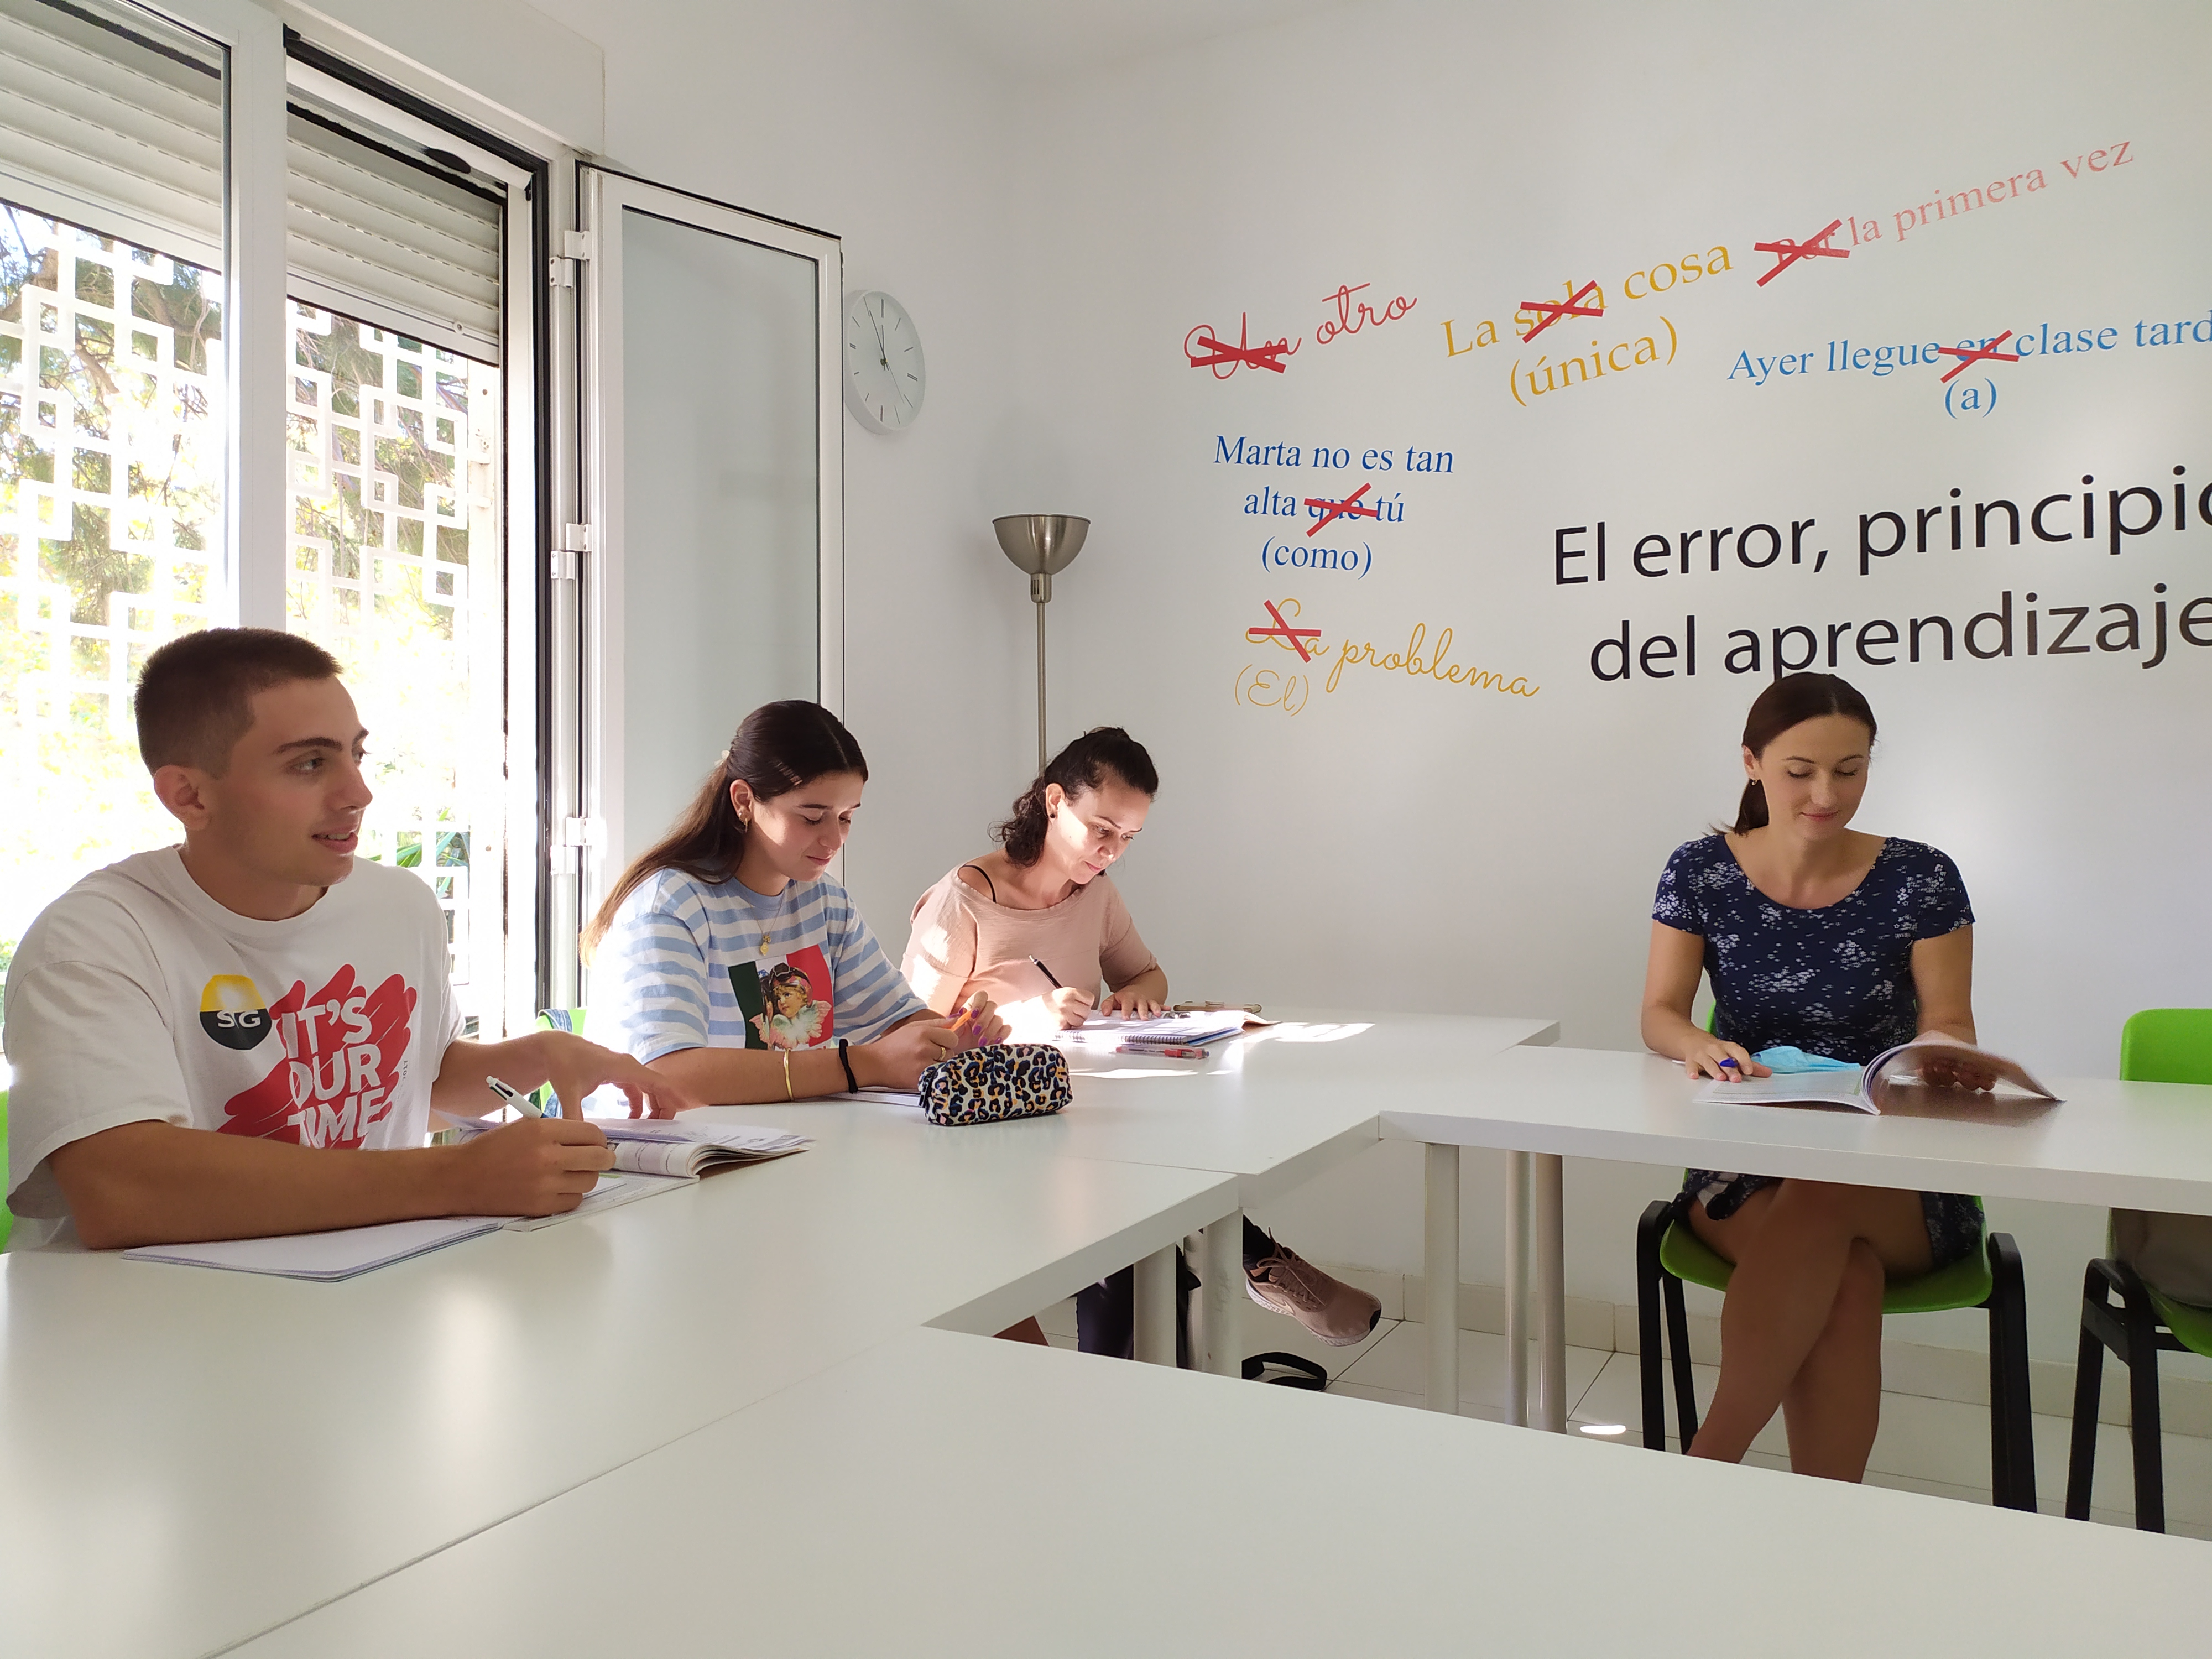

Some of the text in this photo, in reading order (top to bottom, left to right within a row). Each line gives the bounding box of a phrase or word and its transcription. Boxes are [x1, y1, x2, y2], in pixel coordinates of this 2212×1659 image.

[1848, 216, 1882, 246] la
[1893, 169, 2047, 241] primera
[2060, 141, 2134, 179] vez
[1317, 283, 1418, 345] otro
[1441, 244, 1734, 357] La sola cosa
[1510, 316, 1678, 407] (única)
[1727, 350, 1814, 386] Ayer
[1827, 340, 1940, 377] llegue
[2016, 322, 2118, 357] clase
[1944, 378, 1997, 419] (a)
[1213, 435, 1454, 473] Marta no es tan
[1244, 486, 1405, 523] alta que tú
[1555, 465, 2212, 585] El error, principi
[1262, 536, 1371, 580] (como)
[1245, 598, 1540, 697] La problema
[1590, 582, 2212, 681] del aprendizaje
[1235, 664, 1309, 717] (El)
[217, 1009, 261, 1028] SG
[281, 997, 372, 1059] IT'S
